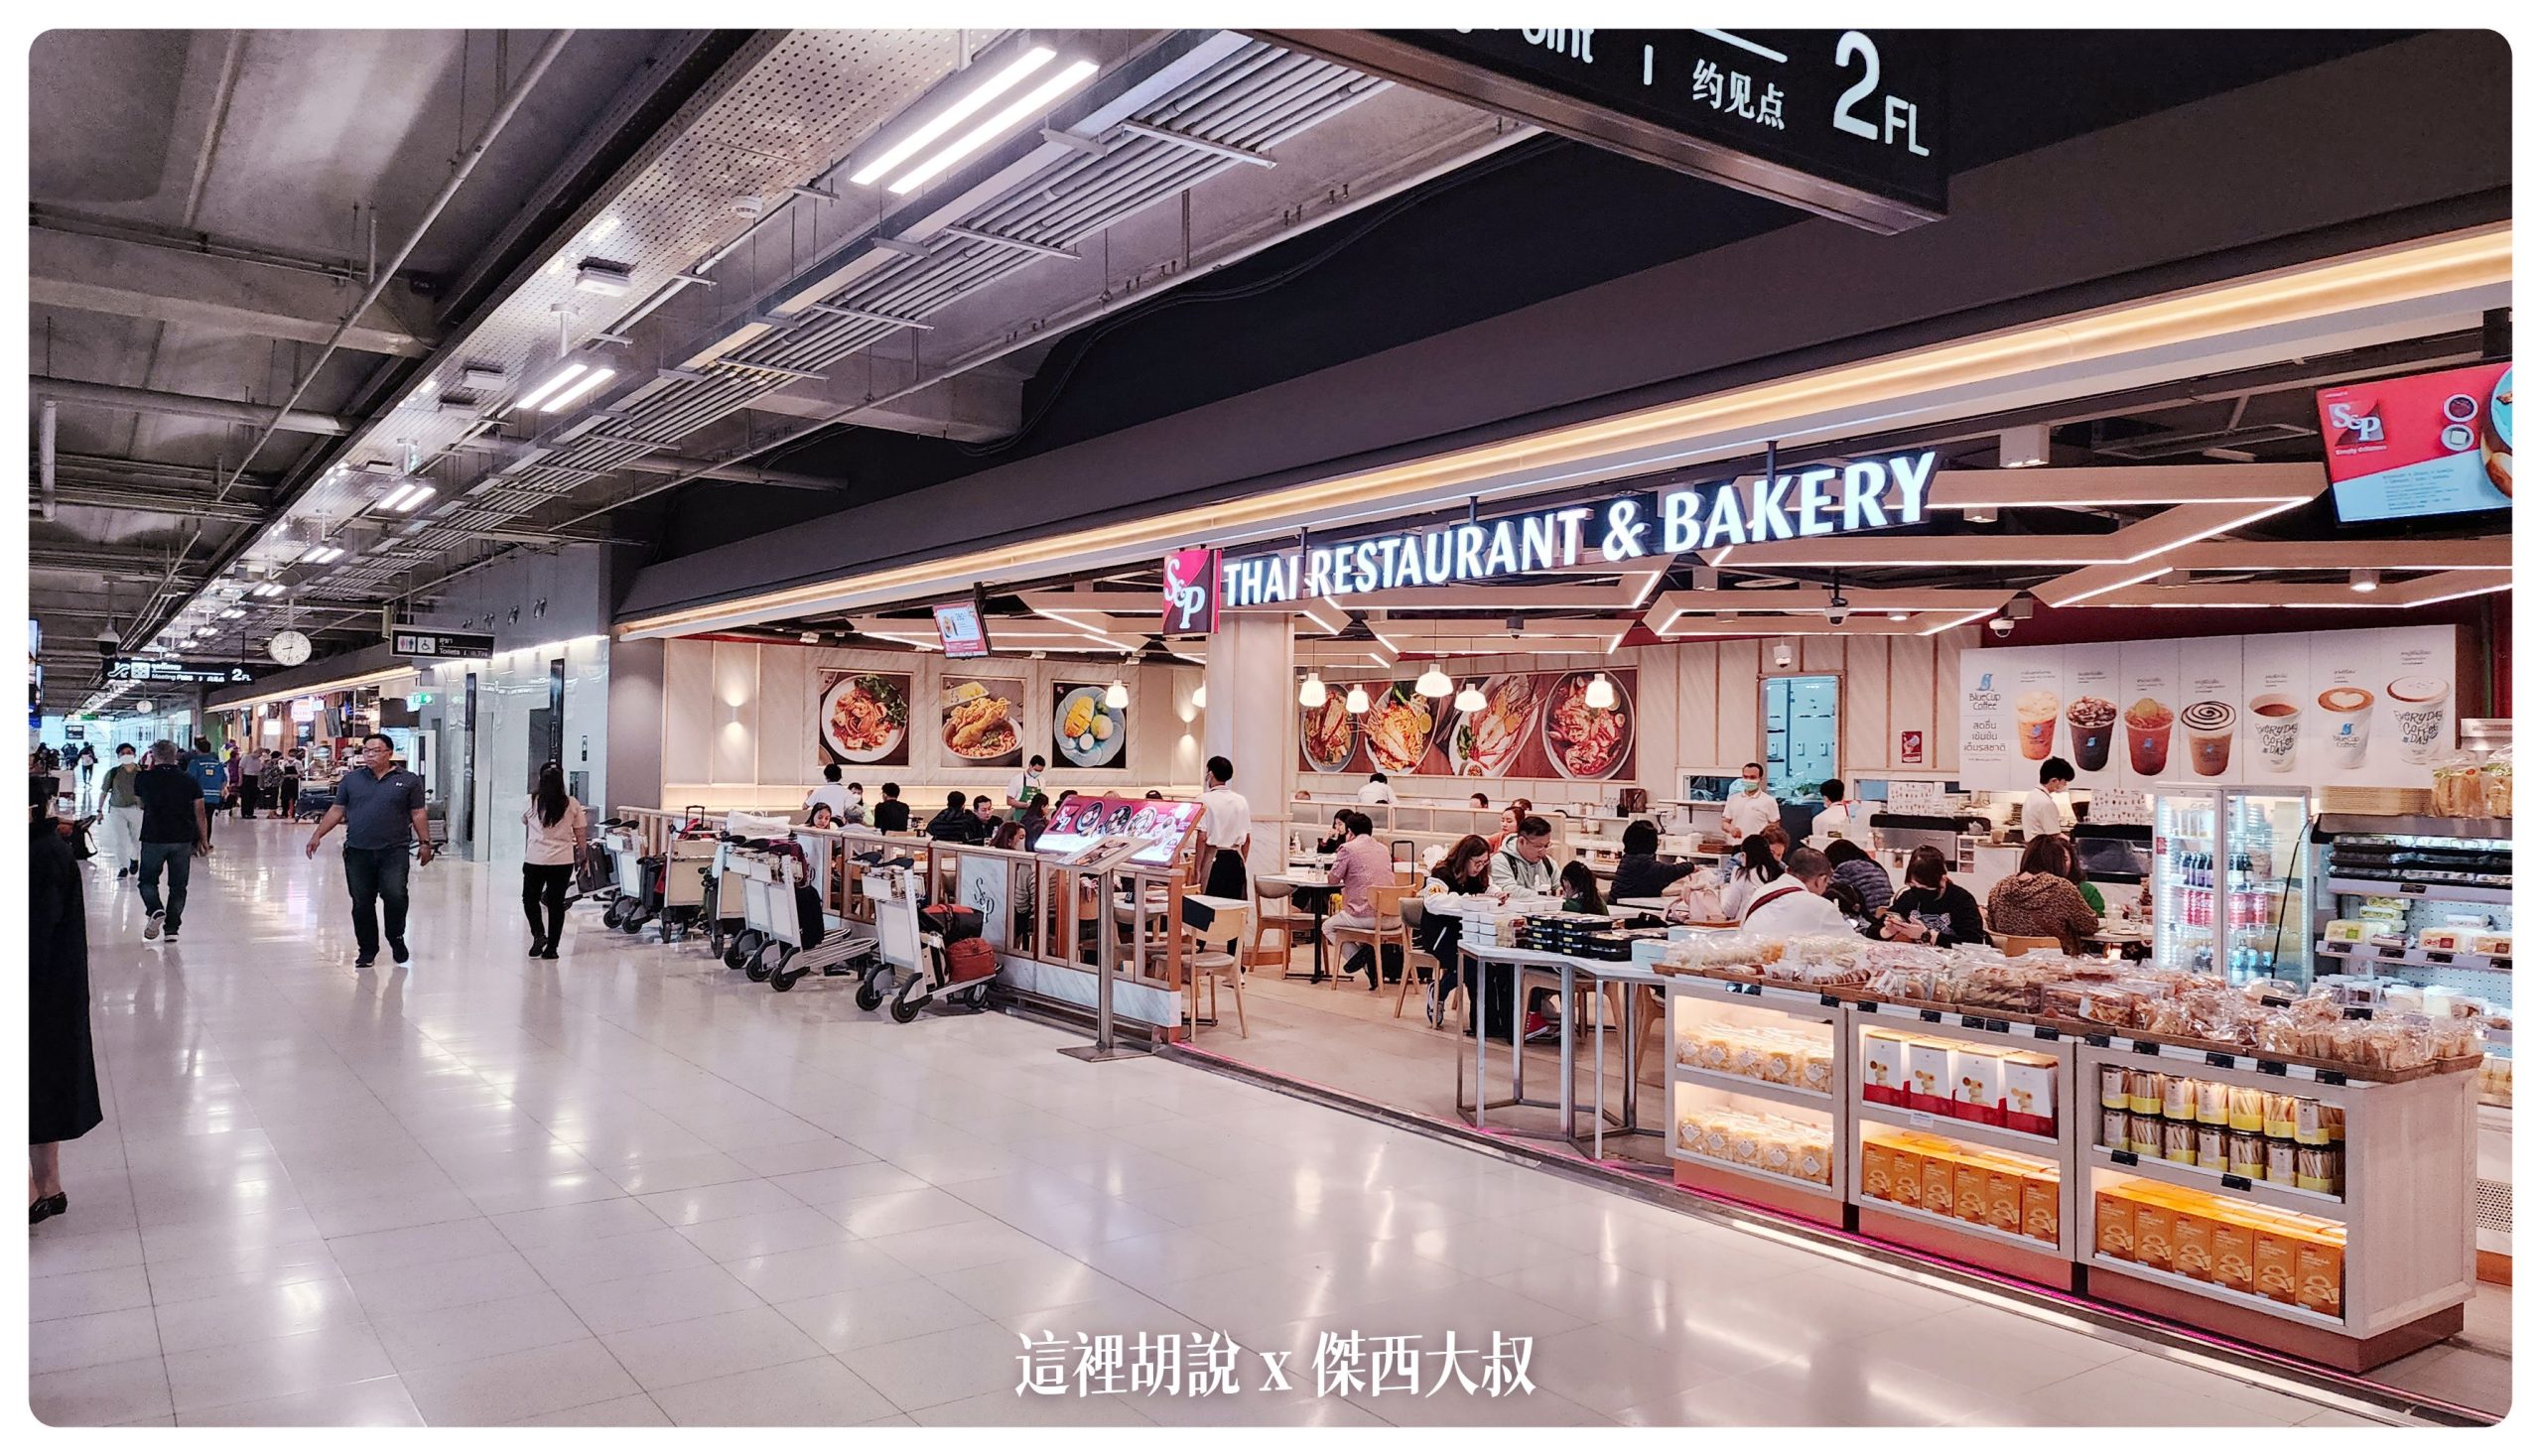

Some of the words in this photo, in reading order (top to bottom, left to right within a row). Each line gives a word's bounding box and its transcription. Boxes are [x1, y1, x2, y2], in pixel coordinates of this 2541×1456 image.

[1497, 29, 1594, 64] oint
[1692, 58, 1786, 130] 约见点
[1223, 555, 1303, 606] THAI
[1309, 510, 1588, 597] RESTAURANT
[1602, 500, 1646, 563] &
[1664, 452, 1937, 553] BAKERY
[1164, 558, 1206, 629] S&P
[1972, 702, 1997, 711] Coffee
